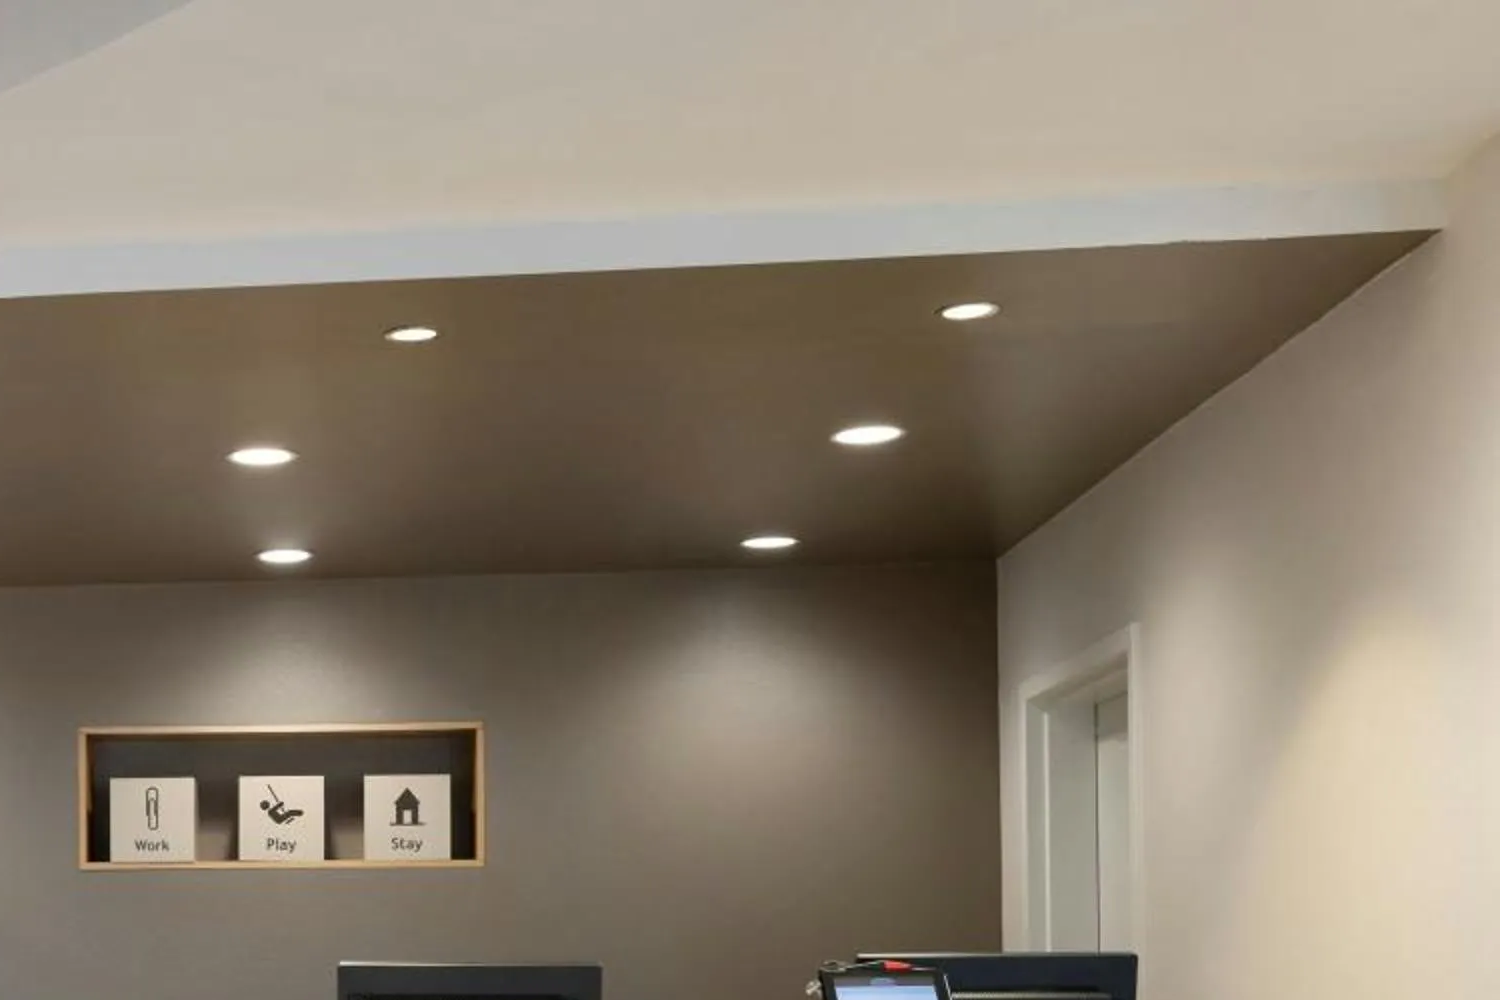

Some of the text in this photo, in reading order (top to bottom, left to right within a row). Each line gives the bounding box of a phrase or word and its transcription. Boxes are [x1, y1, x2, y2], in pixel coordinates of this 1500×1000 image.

[134, 838, 170, 852] Work
[265, 837, 297, 853] Play
[390, 836, 423, 852] Stay
